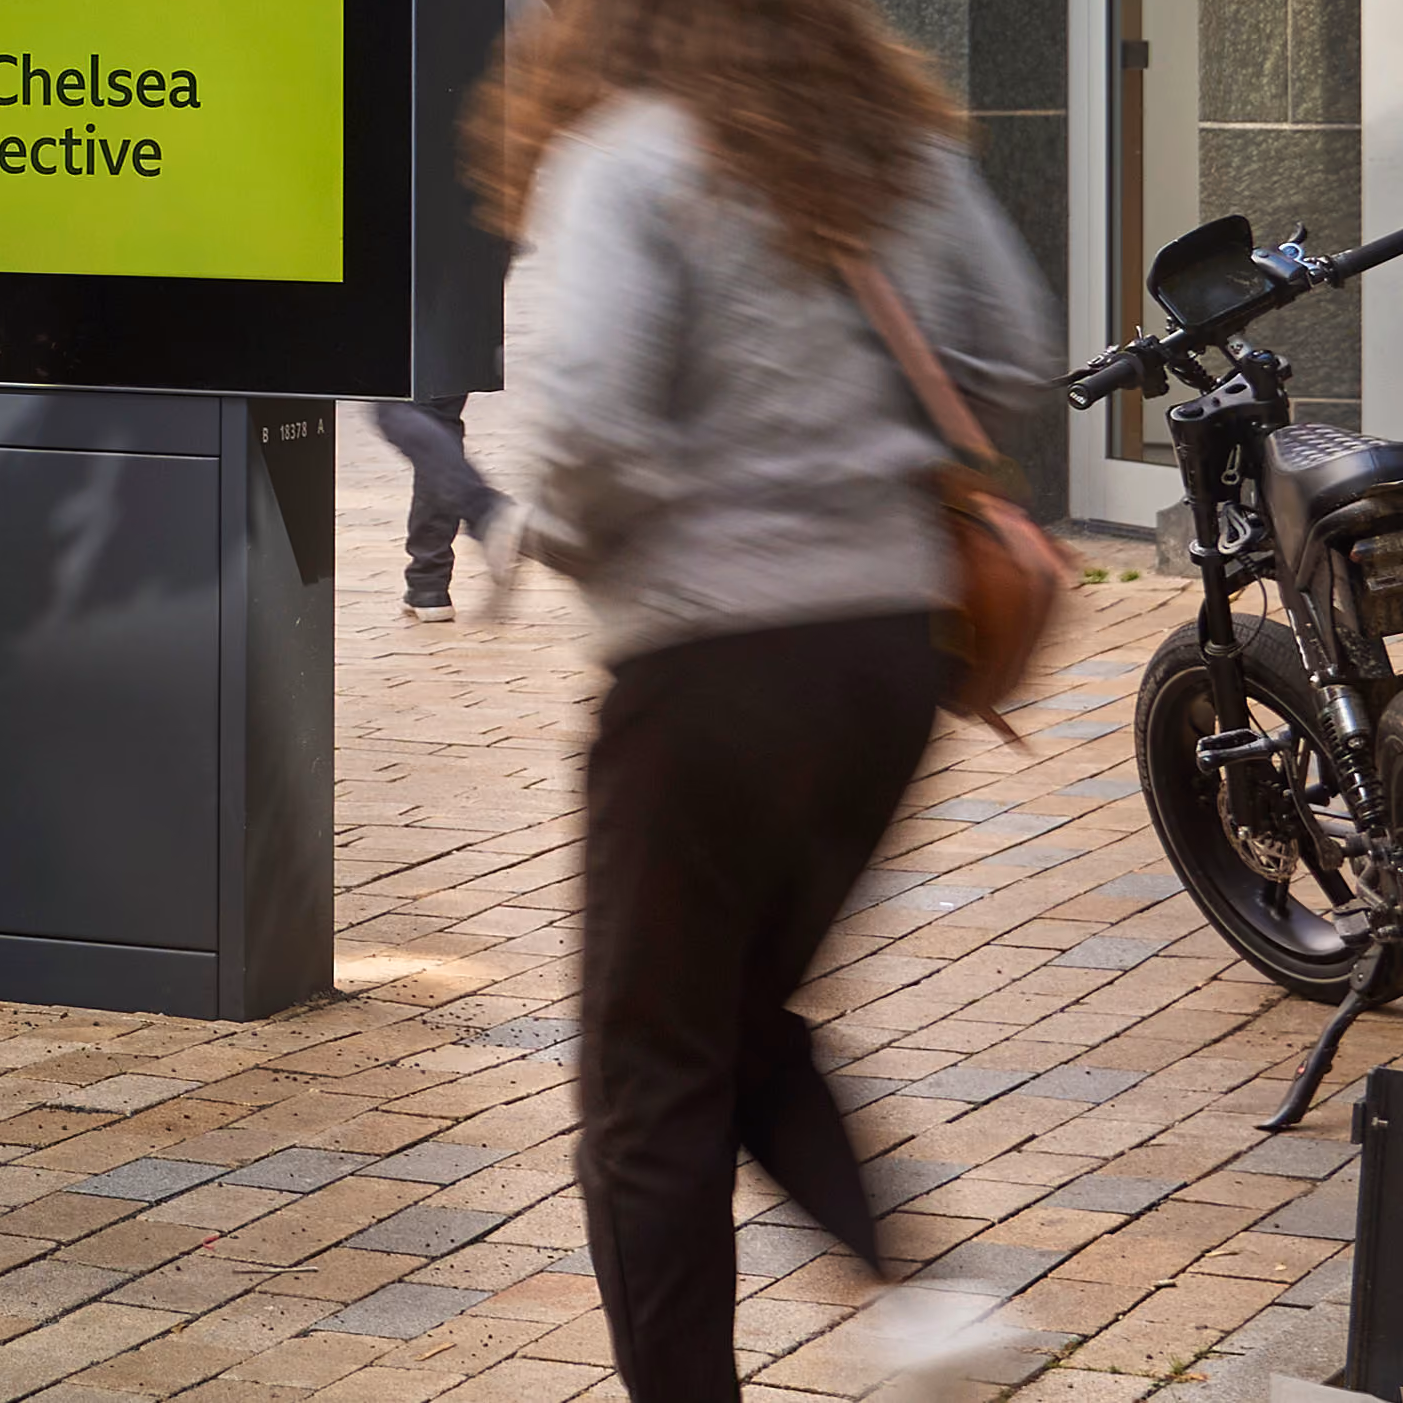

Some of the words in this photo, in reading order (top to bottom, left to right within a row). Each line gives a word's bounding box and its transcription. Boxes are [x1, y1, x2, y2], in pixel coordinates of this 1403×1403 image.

[262, 427, 269, 443] B
[279, 421, 308, 442] 18378
[317, 418, 325, 434] A
